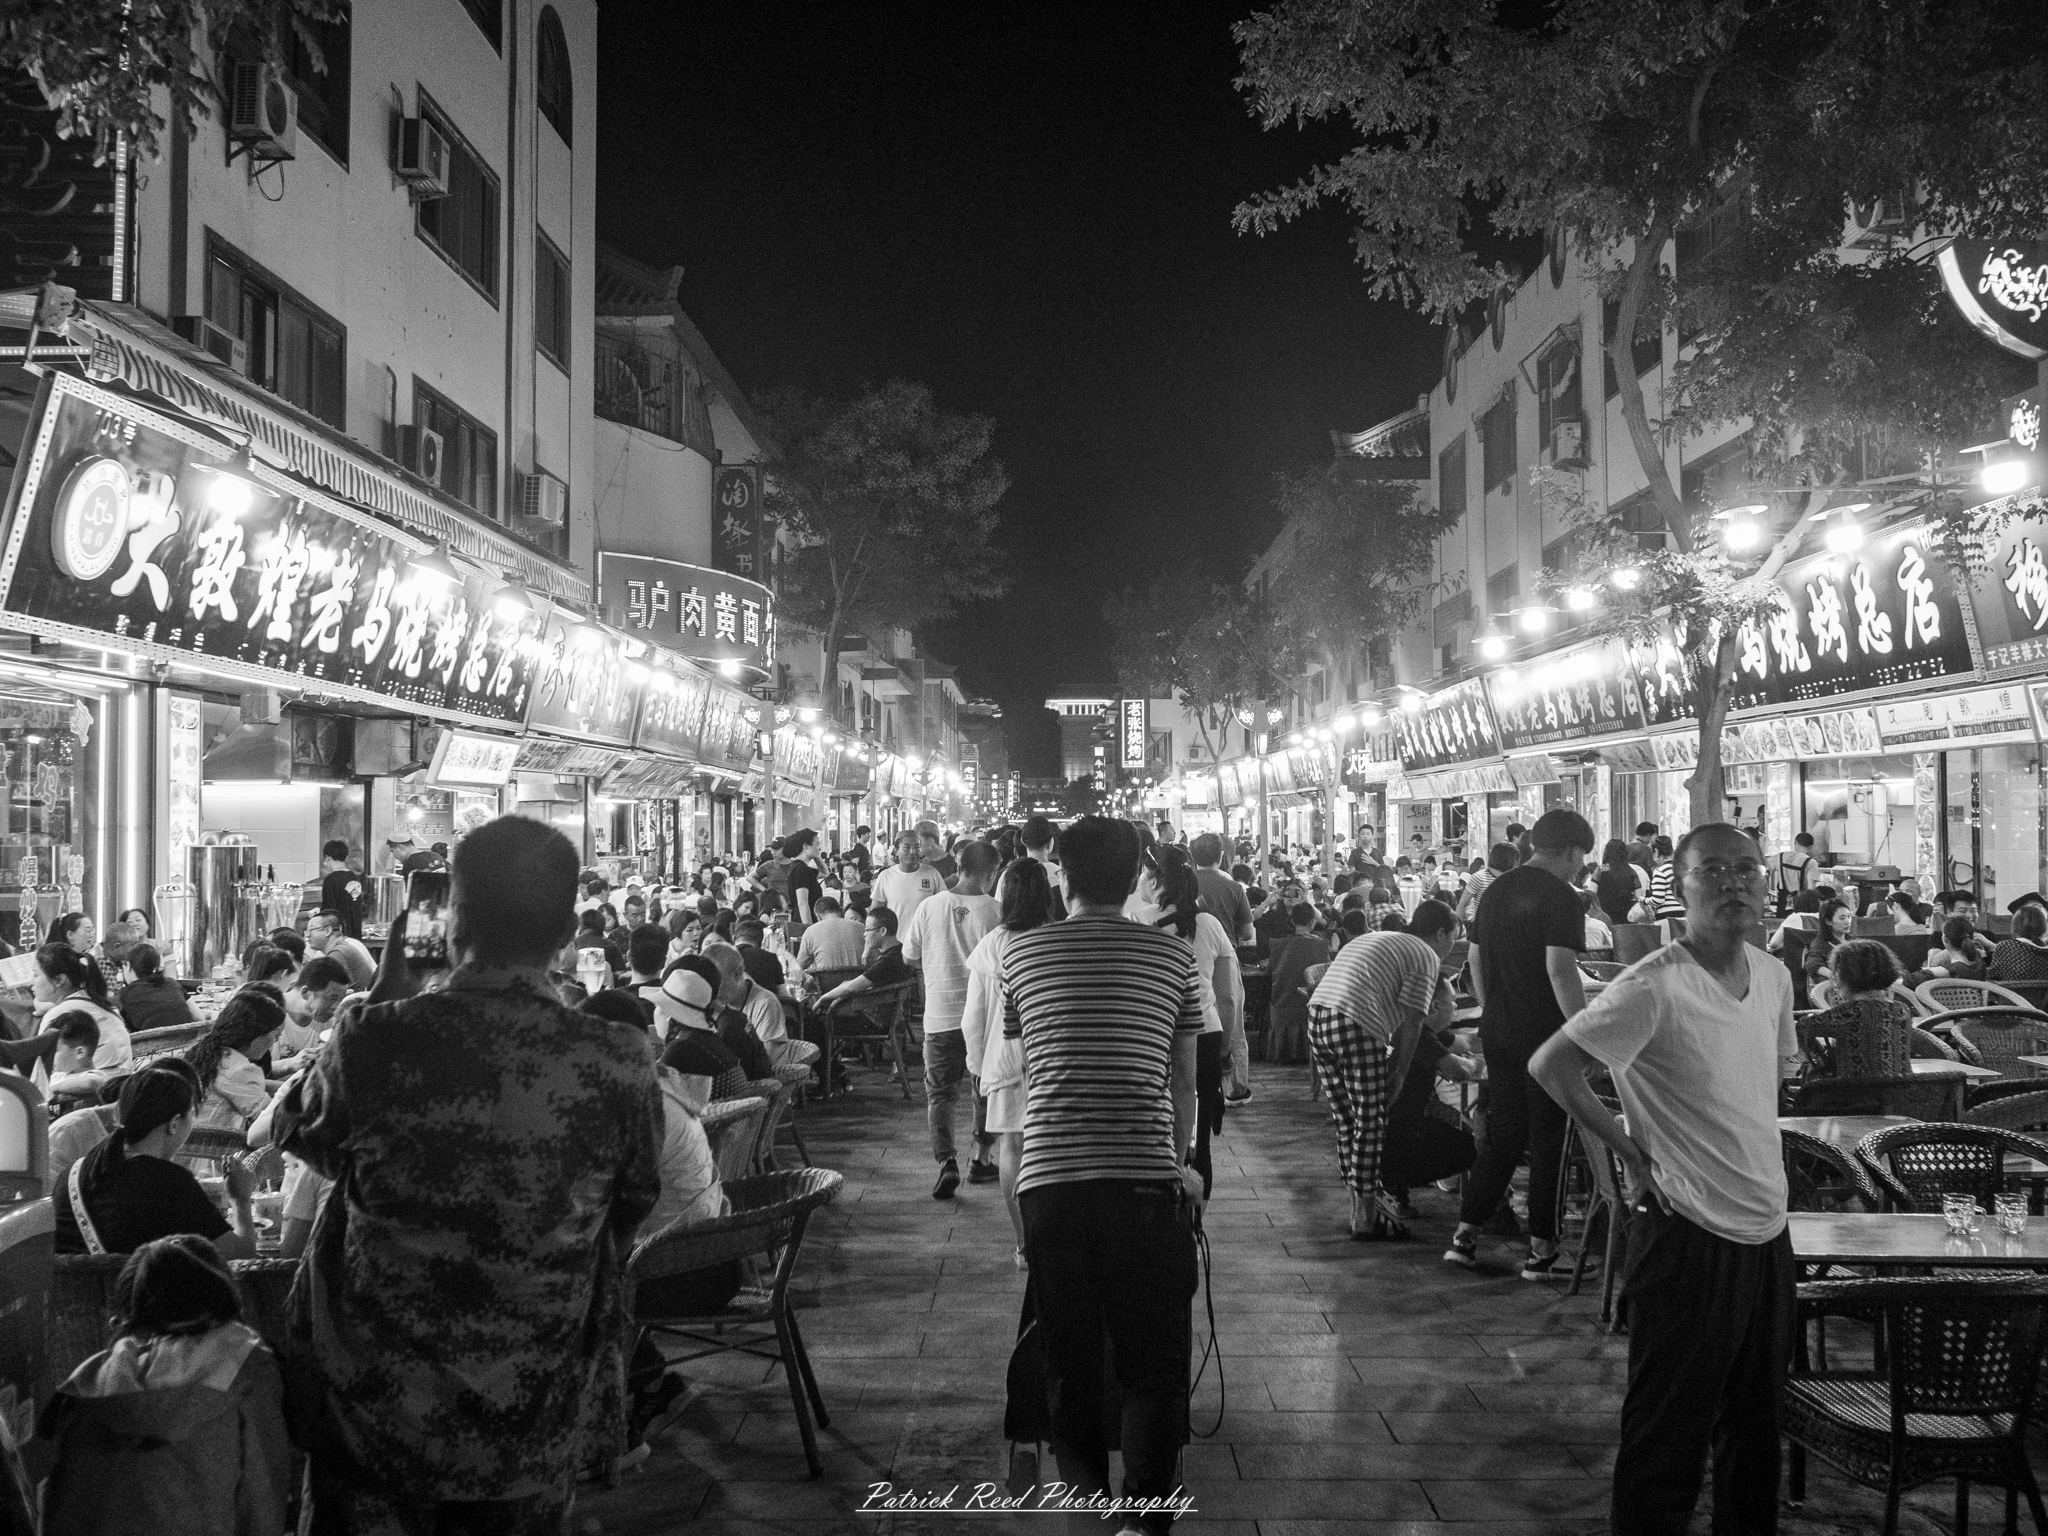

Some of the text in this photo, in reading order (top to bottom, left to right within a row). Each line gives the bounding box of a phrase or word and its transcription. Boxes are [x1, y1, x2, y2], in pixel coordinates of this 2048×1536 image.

[628, 580, 761, 647] 驴肉黄面
[1127, 701, 1142, 760] 老张烧烤
